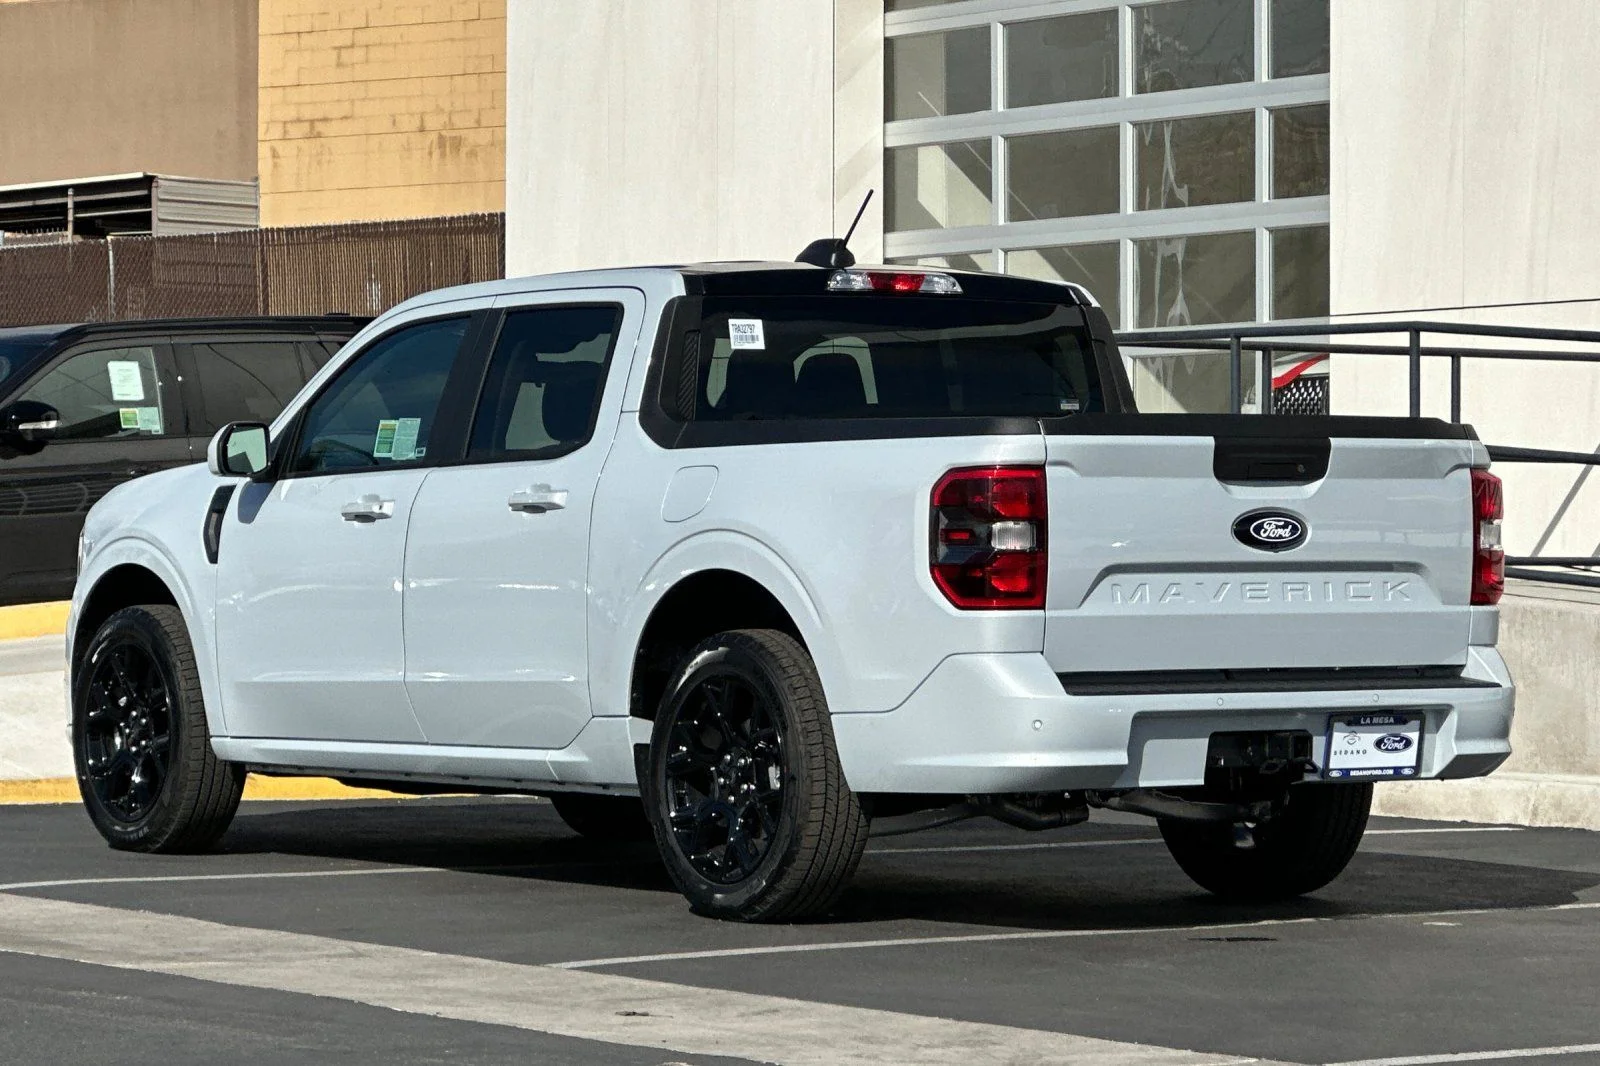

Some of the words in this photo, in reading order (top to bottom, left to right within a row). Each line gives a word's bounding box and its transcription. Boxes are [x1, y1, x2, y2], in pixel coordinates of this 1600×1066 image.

[1260, 520, 1292, 538] Ford
[1110, 580, 1412, 604] MAVERICK
[1360, 717, 1371, 725] LA
[1372, 716, 1395, 724] MESA
[1380, 736, 1406, 750] Ford
